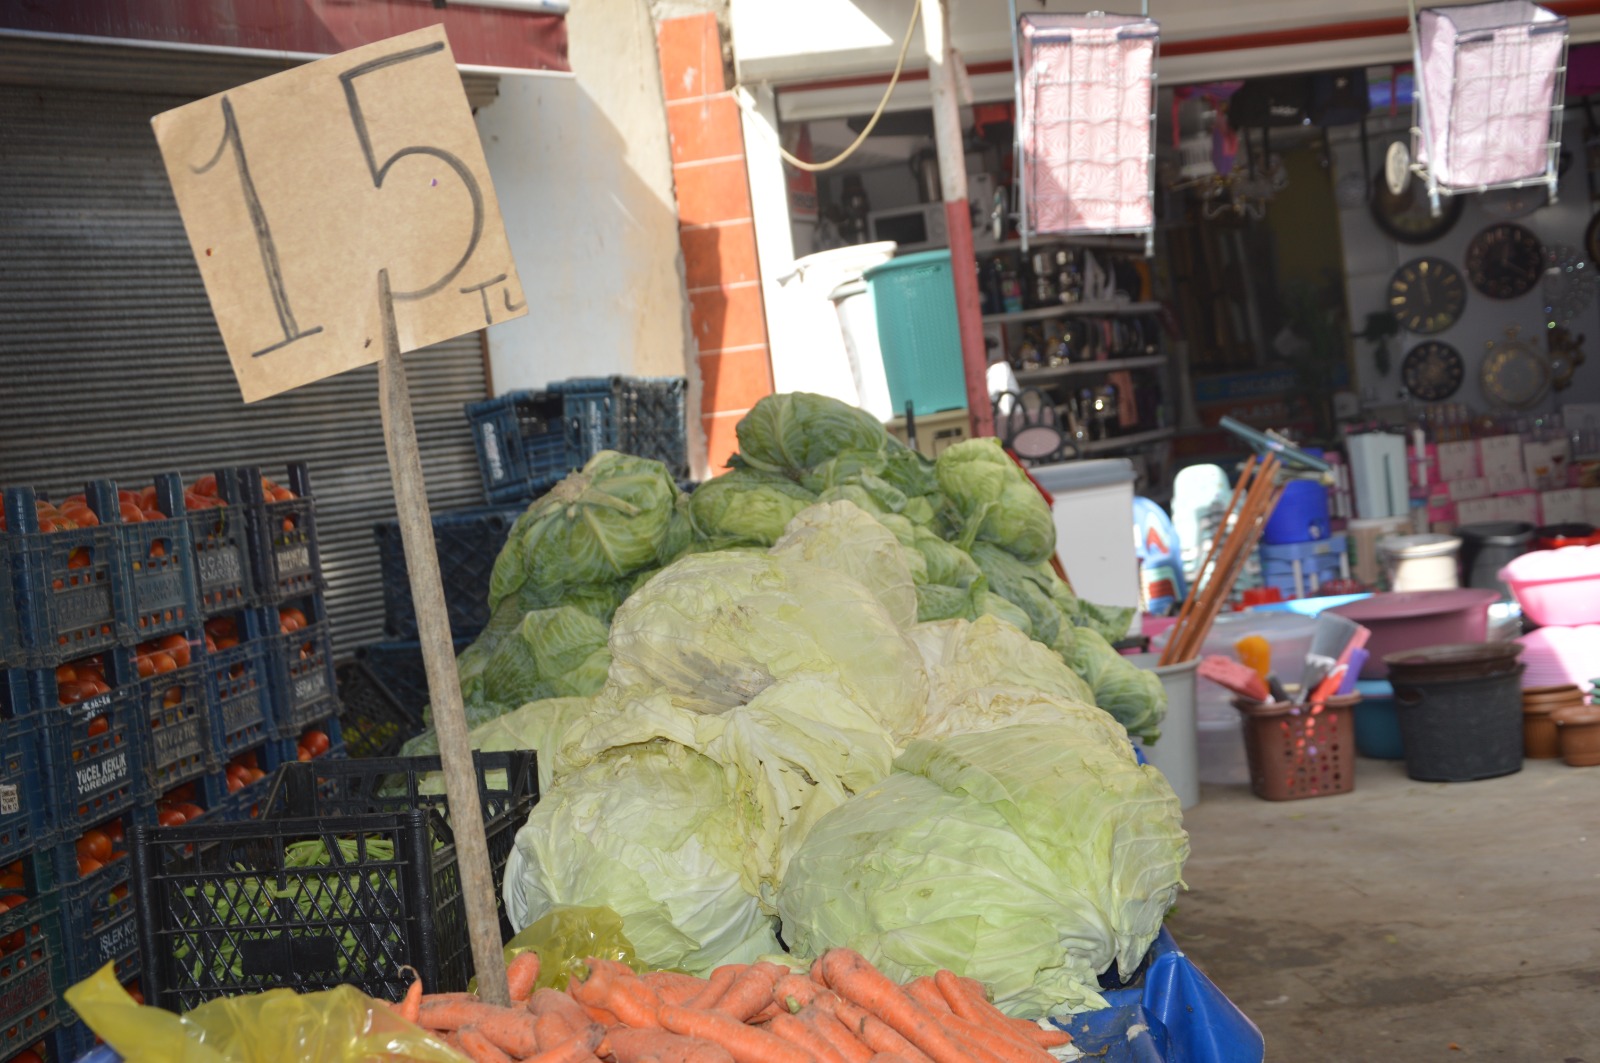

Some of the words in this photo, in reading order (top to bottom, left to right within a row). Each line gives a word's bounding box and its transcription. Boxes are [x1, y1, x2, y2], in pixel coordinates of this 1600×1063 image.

[190, 40, 484, 358] 15
[76, 763, 101, 786] YÜCEL
[101, 753, 127, 777] KEKLİK
